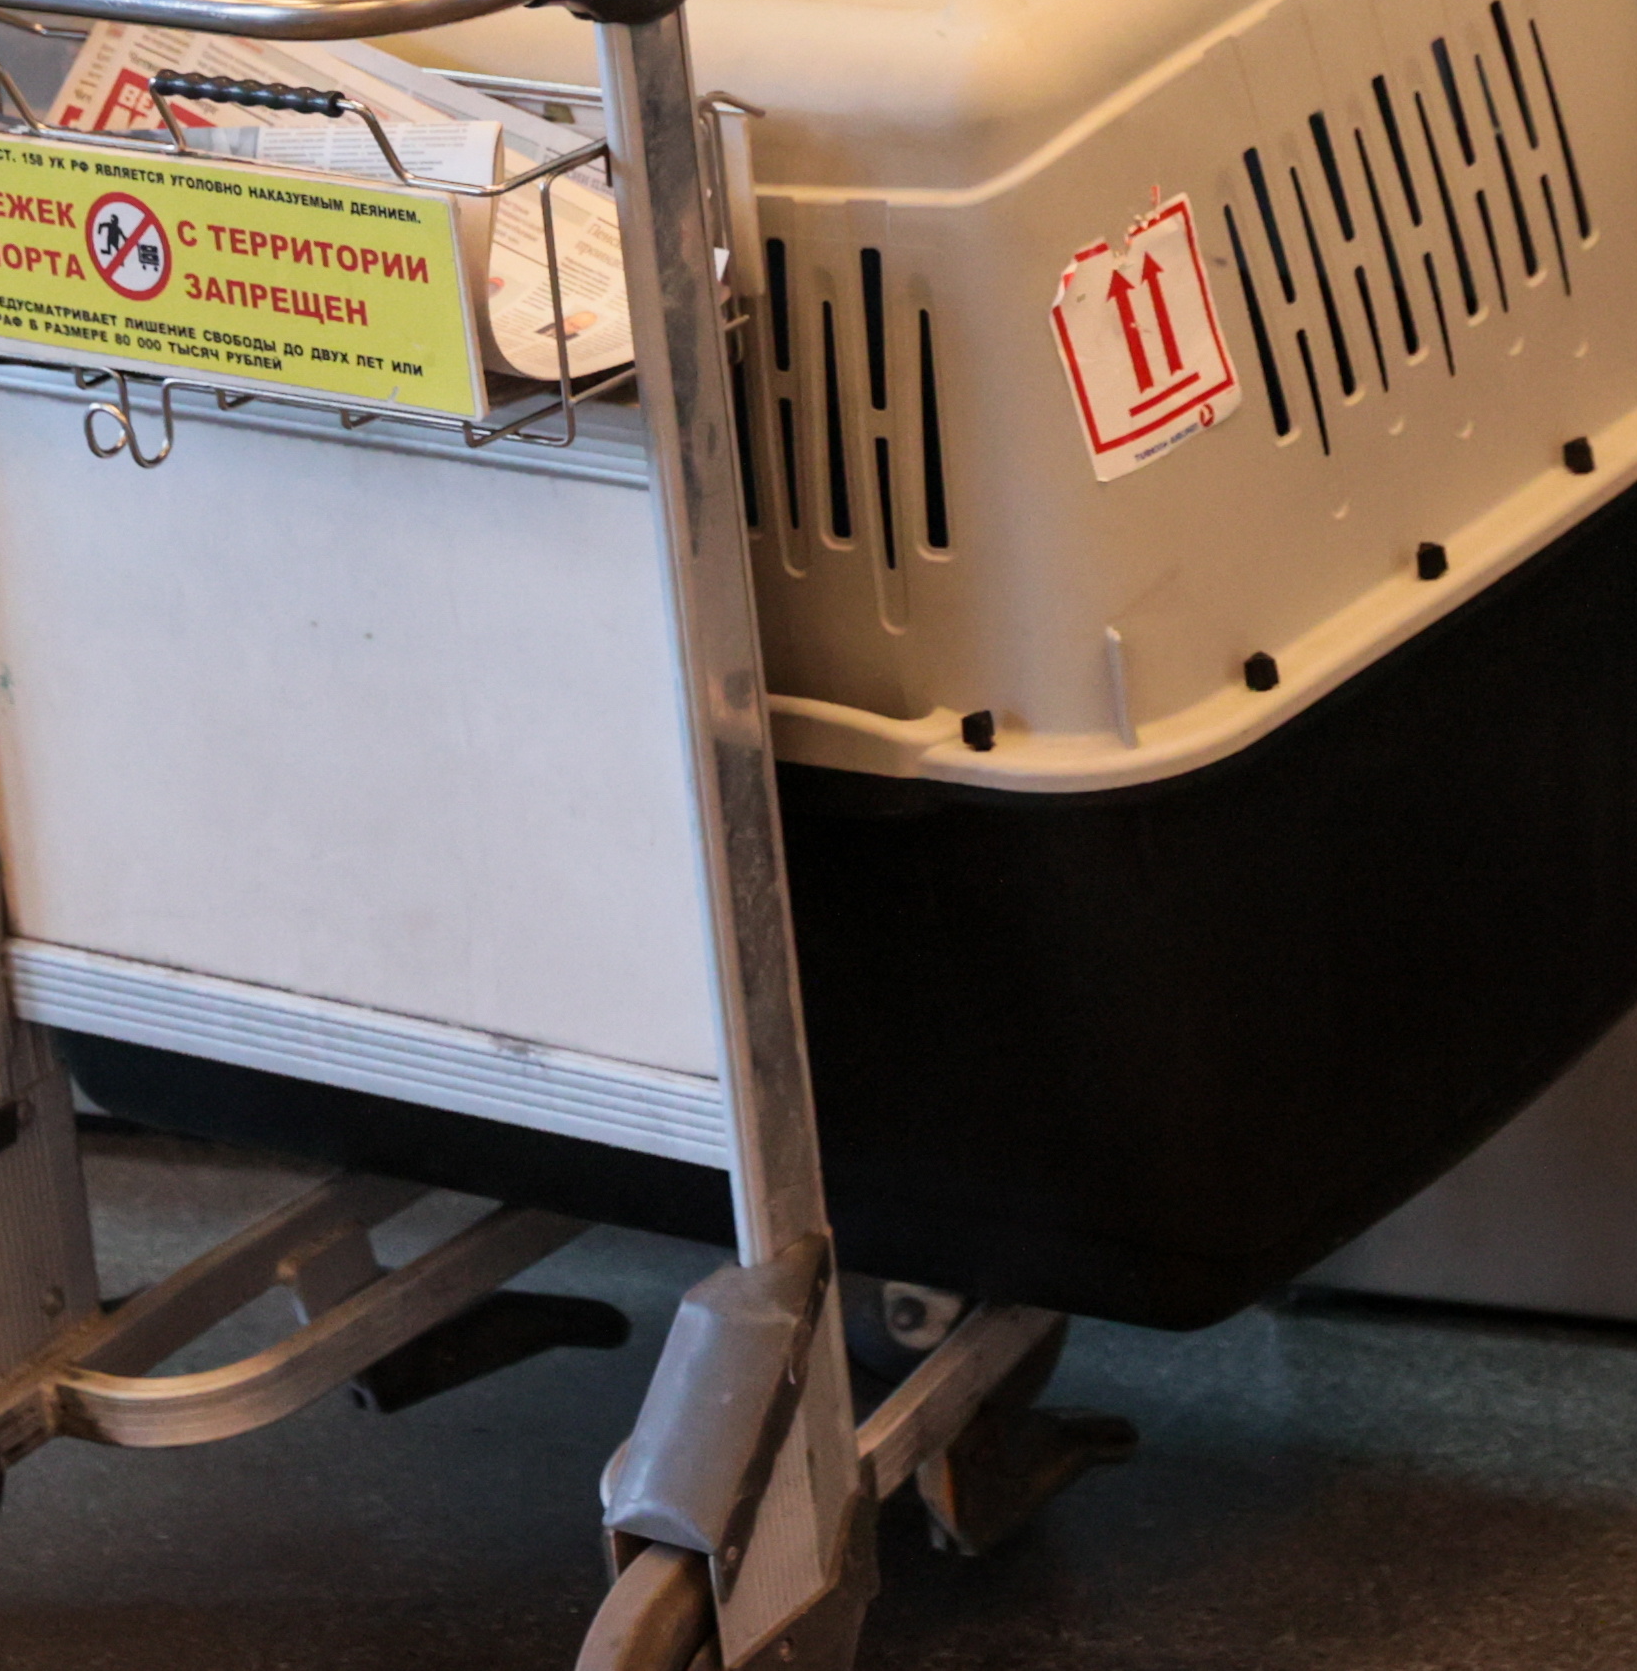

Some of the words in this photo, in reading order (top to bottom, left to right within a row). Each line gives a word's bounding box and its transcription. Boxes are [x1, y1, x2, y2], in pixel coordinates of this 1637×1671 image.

[22, 152, 44, 167] 158
[49, 157, 66, 170] УК
[70, 159, 89, 173] РФ
[95, 163, 165, 185] ЯВЛЯЕТСЯ
[170, 174, 243, 197] УГОЛОВНО
[248, 187, 345, 212] НАКАЗУЕМЫМ
[350, 201, 422, 224] ДЕЯНИЕМ.
[176, 219, 198, 248] С
[206, 224, 430, 284] ТЕРРИТОРИИ
[183, 273, 369, 326] ЗАПРЕЩЕН
[29, 319, 39, 331] В
[45, 321, 109, 343] РАЗМЕРЕ
[114, 332, 131, 347] 80
[137, 338, 162, 351] 000
[167, 341, 220, 360] ТЫСЯЧ
[226, 352, 283, 371] РУБЛЕЙ
[125, 317, 197, 339] ЛИШЕНИЕ
[203, 330, 277, 353] СВОБОДЫ
[283, 342, 304, 357] ДО
[311, 347, 350, 365] ДВУХ
[356, 355, 385, 370] ЛЕТ
[391, 361, 424, 377] ИЛИ
